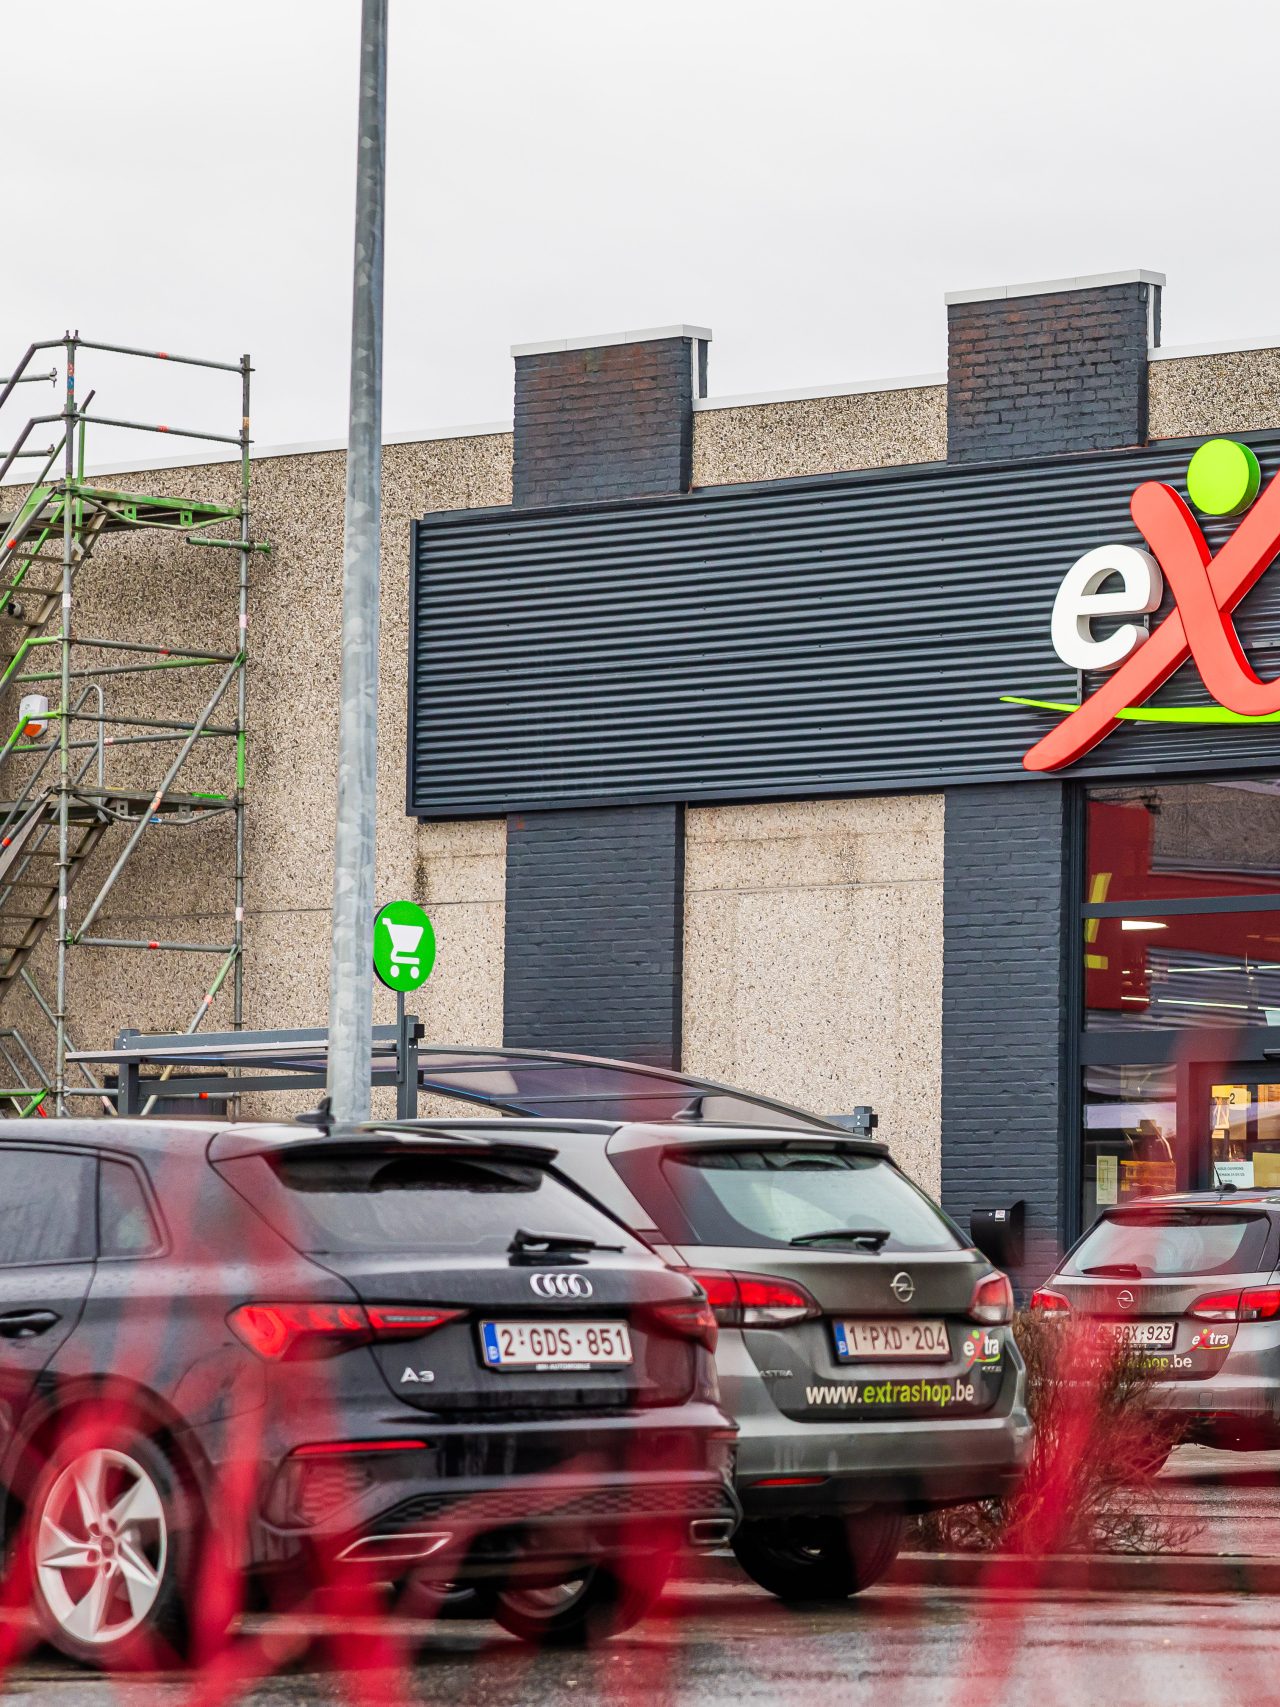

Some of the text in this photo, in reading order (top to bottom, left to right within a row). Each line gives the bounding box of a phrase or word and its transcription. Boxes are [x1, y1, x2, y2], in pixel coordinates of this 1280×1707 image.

[1229, 1093, 1235, 1104] 2
[400, 1366, 435, 1383] A3
[759, 1369, 794, 1378] ASTRA
[806, 1380, 974, 1407] www.extrashop.be
